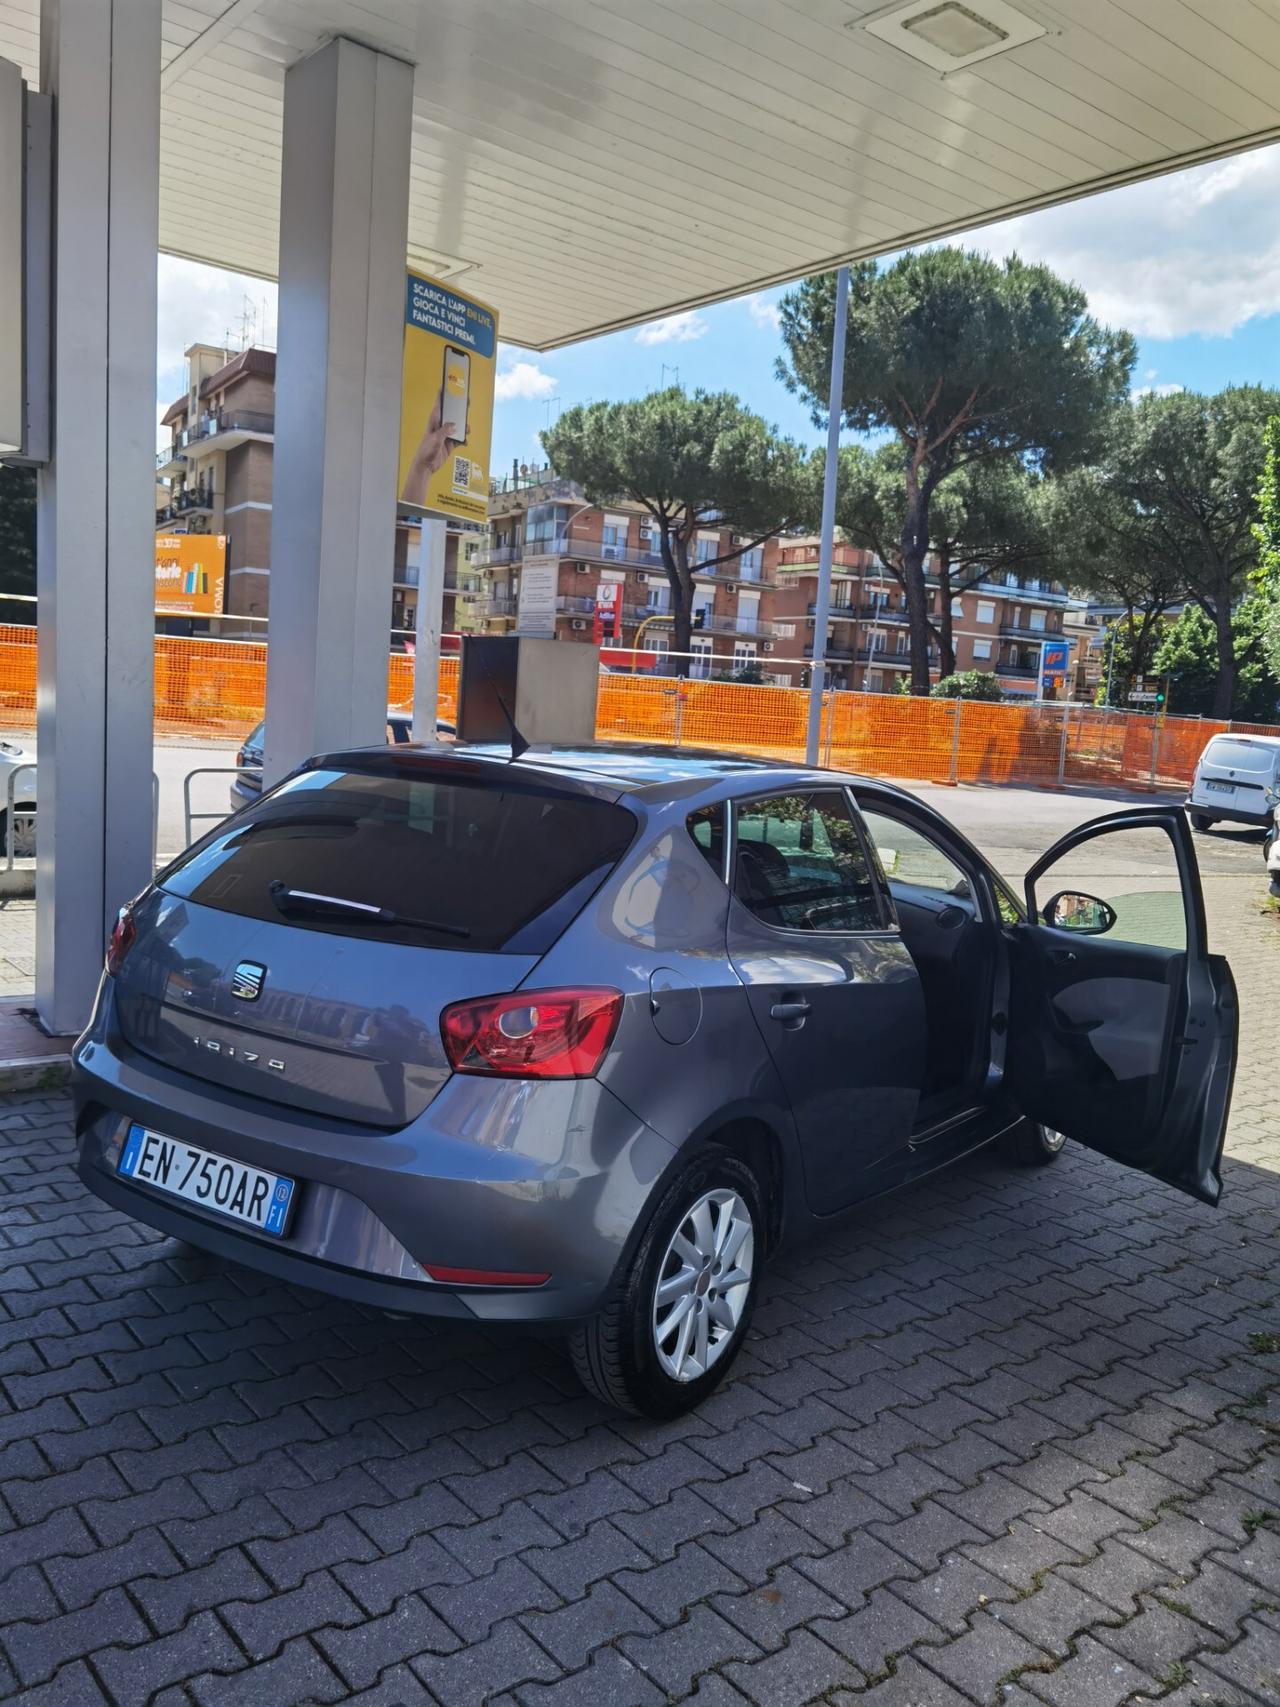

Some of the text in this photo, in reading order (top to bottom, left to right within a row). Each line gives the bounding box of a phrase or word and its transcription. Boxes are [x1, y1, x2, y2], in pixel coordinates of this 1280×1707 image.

[413, 283, 447, 306] SCARICA
[448, 298, 466, 314] L'APP
[413, 296, 466, 327] GIOCA E VINCI
[412, 309, 453, 335] FANTASTICI
[268, 1205, 283, 1228] FI
